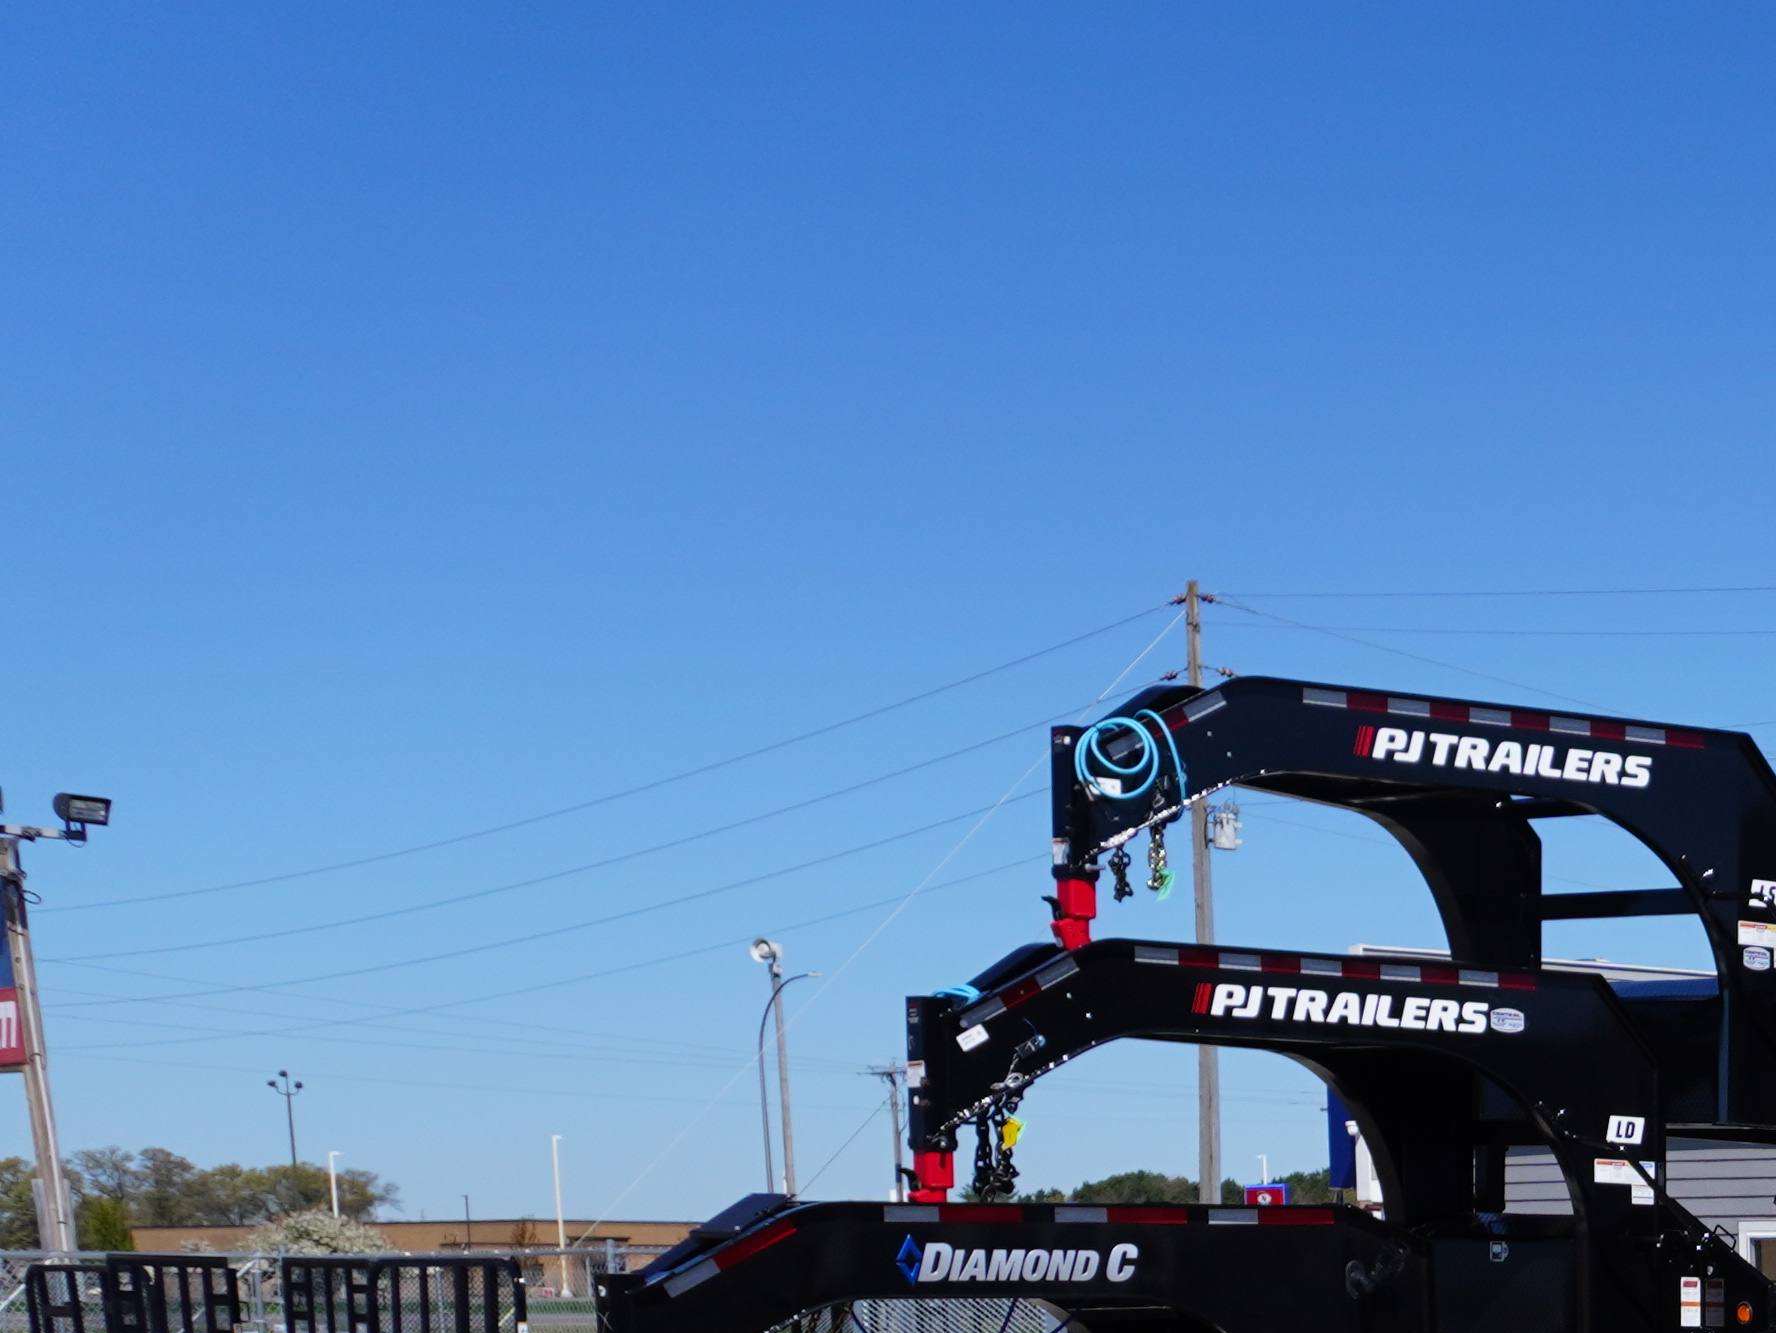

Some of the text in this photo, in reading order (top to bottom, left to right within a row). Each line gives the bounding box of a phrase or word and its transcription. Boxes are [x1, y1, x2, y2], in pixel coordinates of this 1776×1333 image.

[1372, 727, 1652, 788] PJ TRAILERS
[1210, 983, 1489, 1034] PJ TRAILERS
[1616, 1120, 1636, 1139] LD
[917, 1242, 1139, 1282] DIAMOND C
